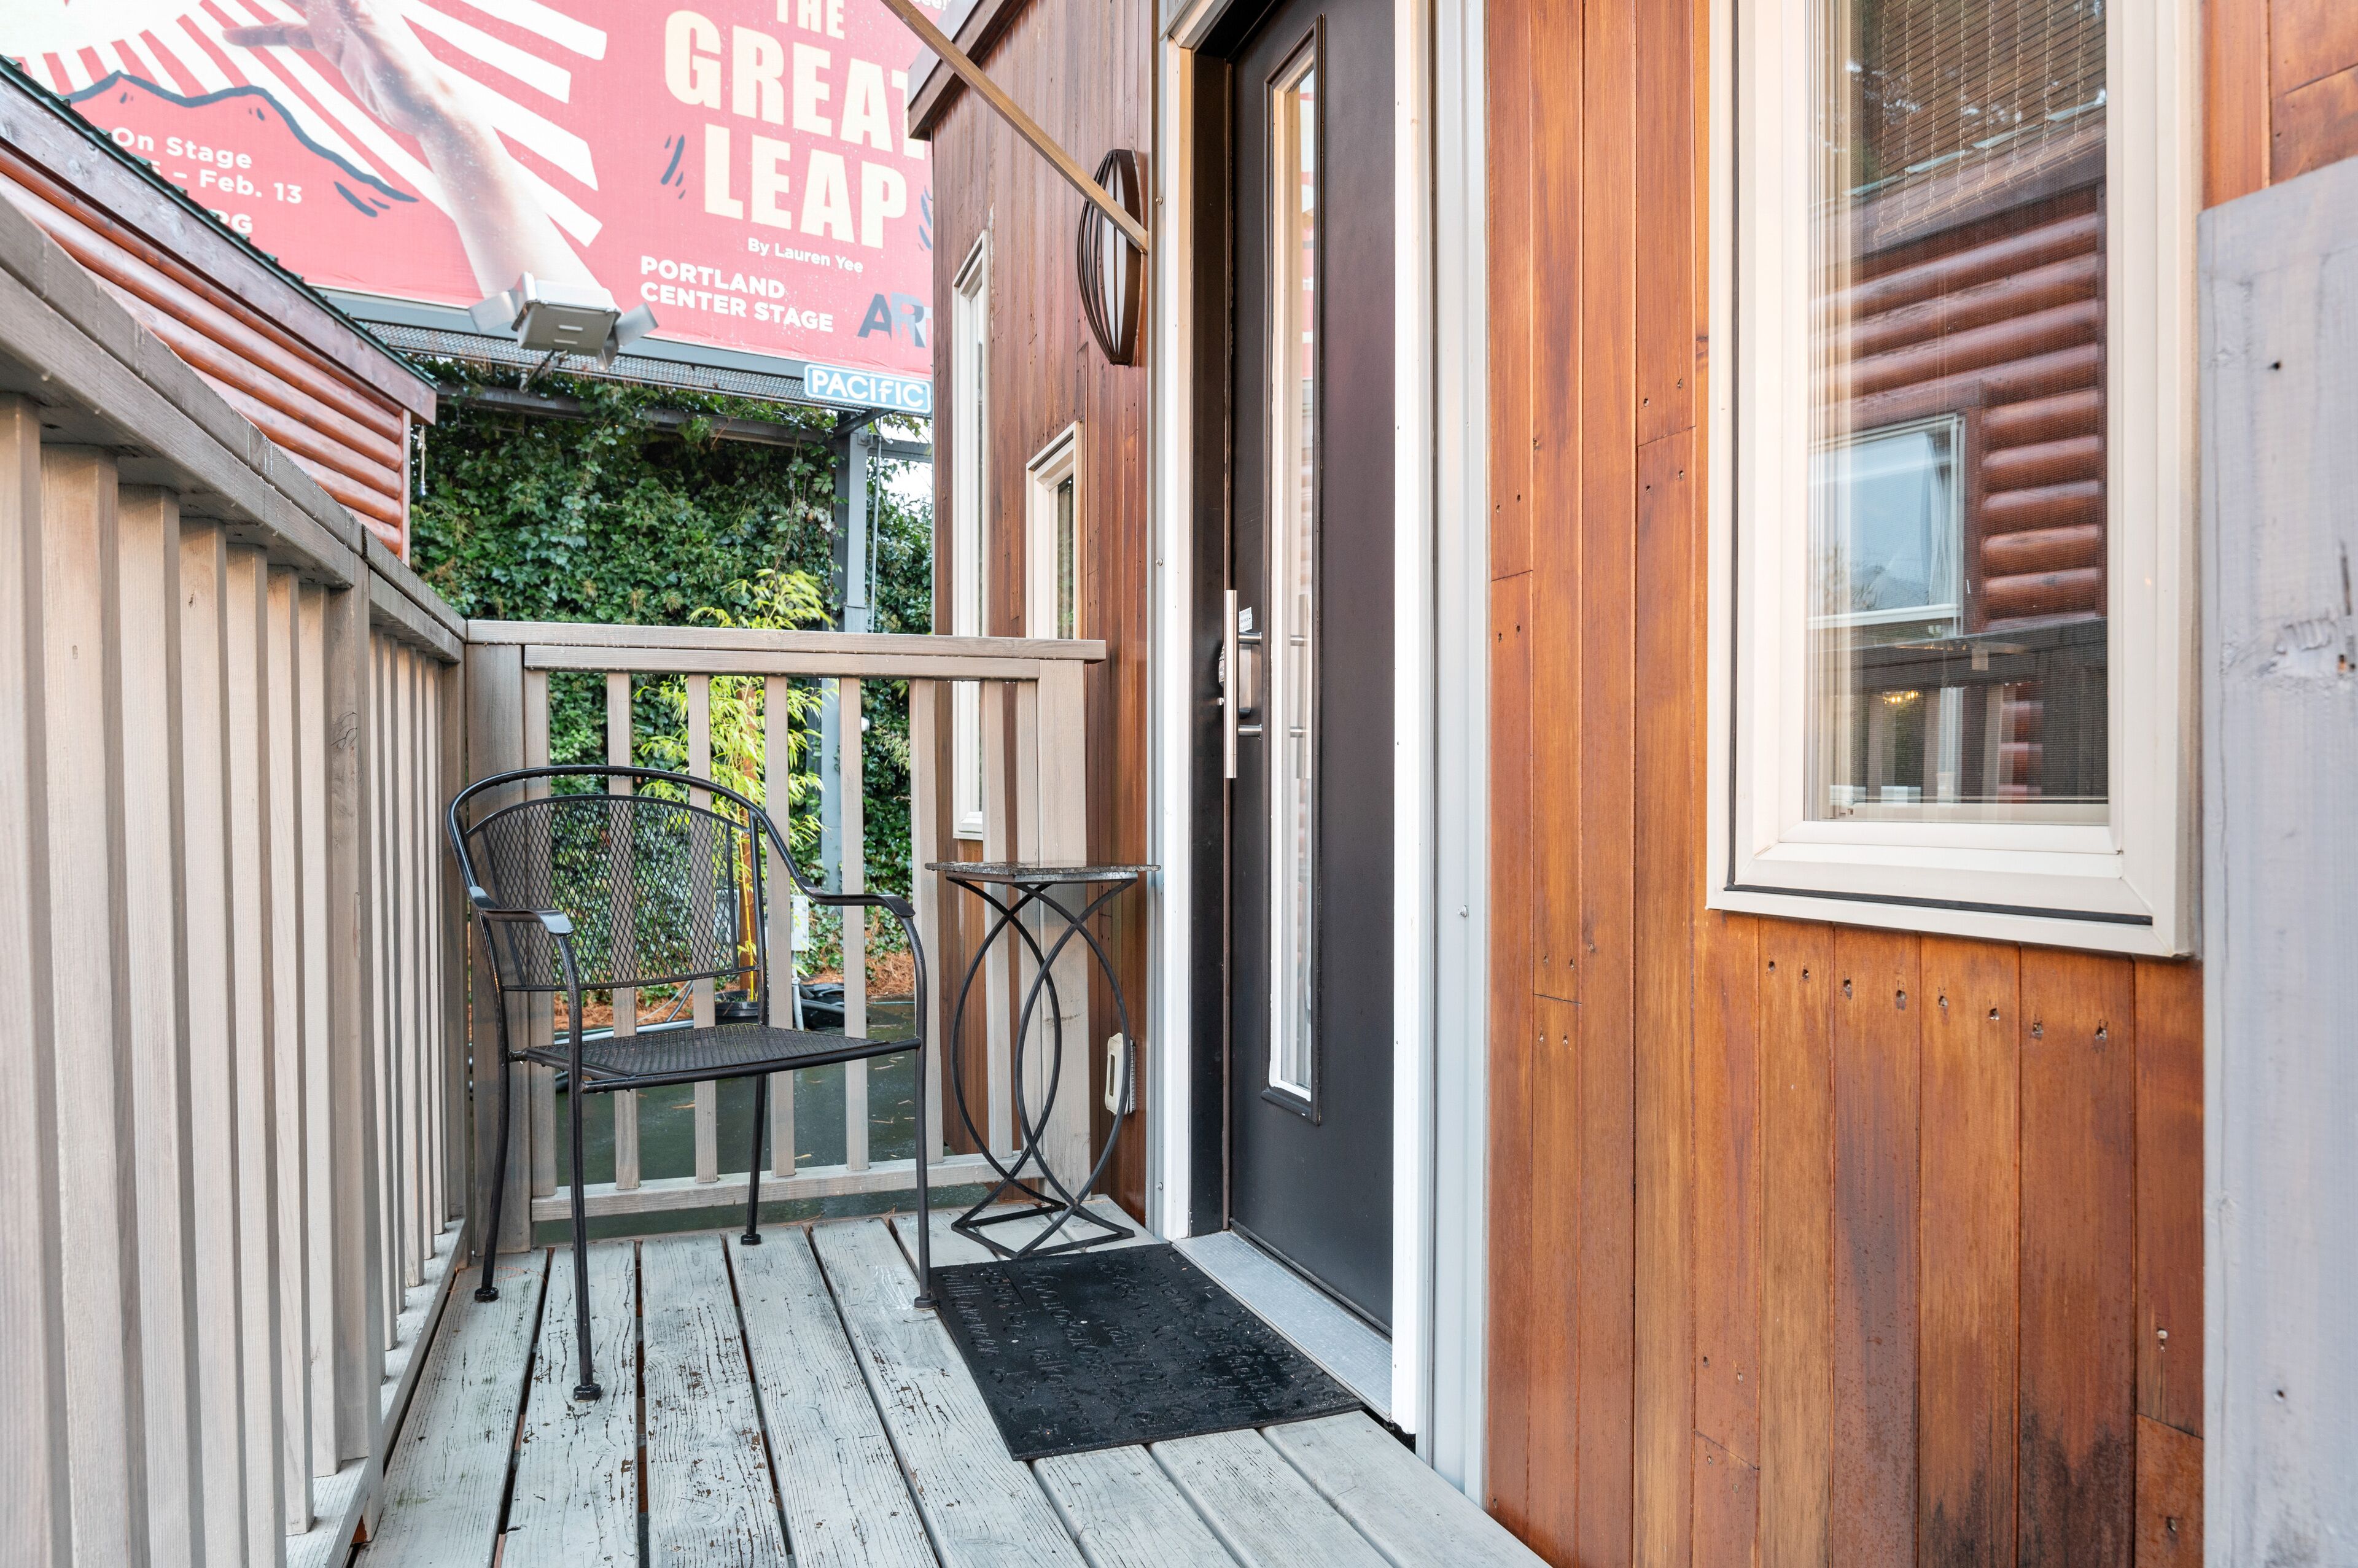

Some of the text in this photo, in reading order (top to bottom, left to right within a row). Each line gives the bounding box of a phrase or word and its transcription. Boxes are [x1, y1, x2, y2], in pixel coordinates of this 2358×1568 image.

[111, 127, 252, 169] On Stage
[200, 169, 262, 197] Feb.
[274, 182, 302, 204] 13
[705, 123, 907, 249] LEAP
[748, 237, 863, 273] By Lauren Yee
[640, 255, 785, 298] PORTLAND
[640, 282, 833, 332] CENTER STAGE
